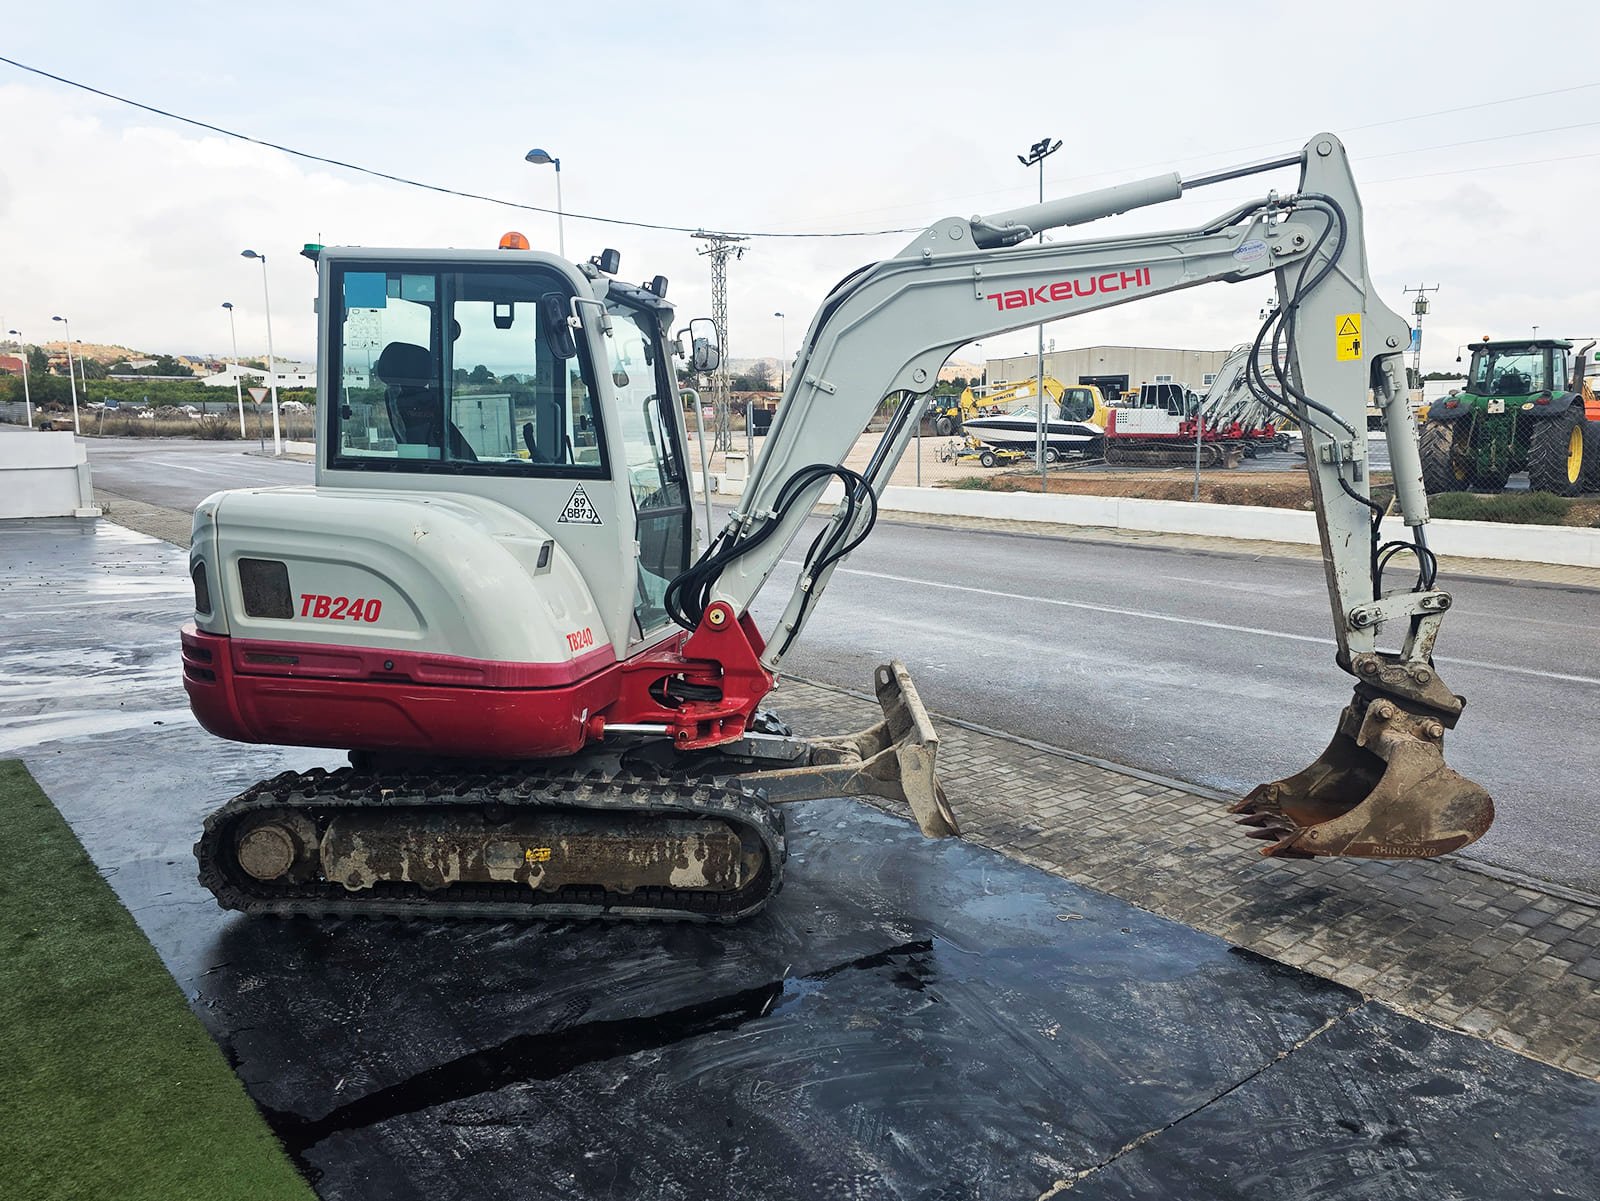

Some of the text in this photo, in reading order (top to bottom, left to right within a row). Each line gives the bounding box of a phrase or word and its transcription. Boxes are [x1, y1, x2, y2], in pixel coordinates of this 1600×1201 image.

[574, 498, 586, 508] 89
[301, 594, 382, 623] TB240
[566, 627, 593, 652] TB240
